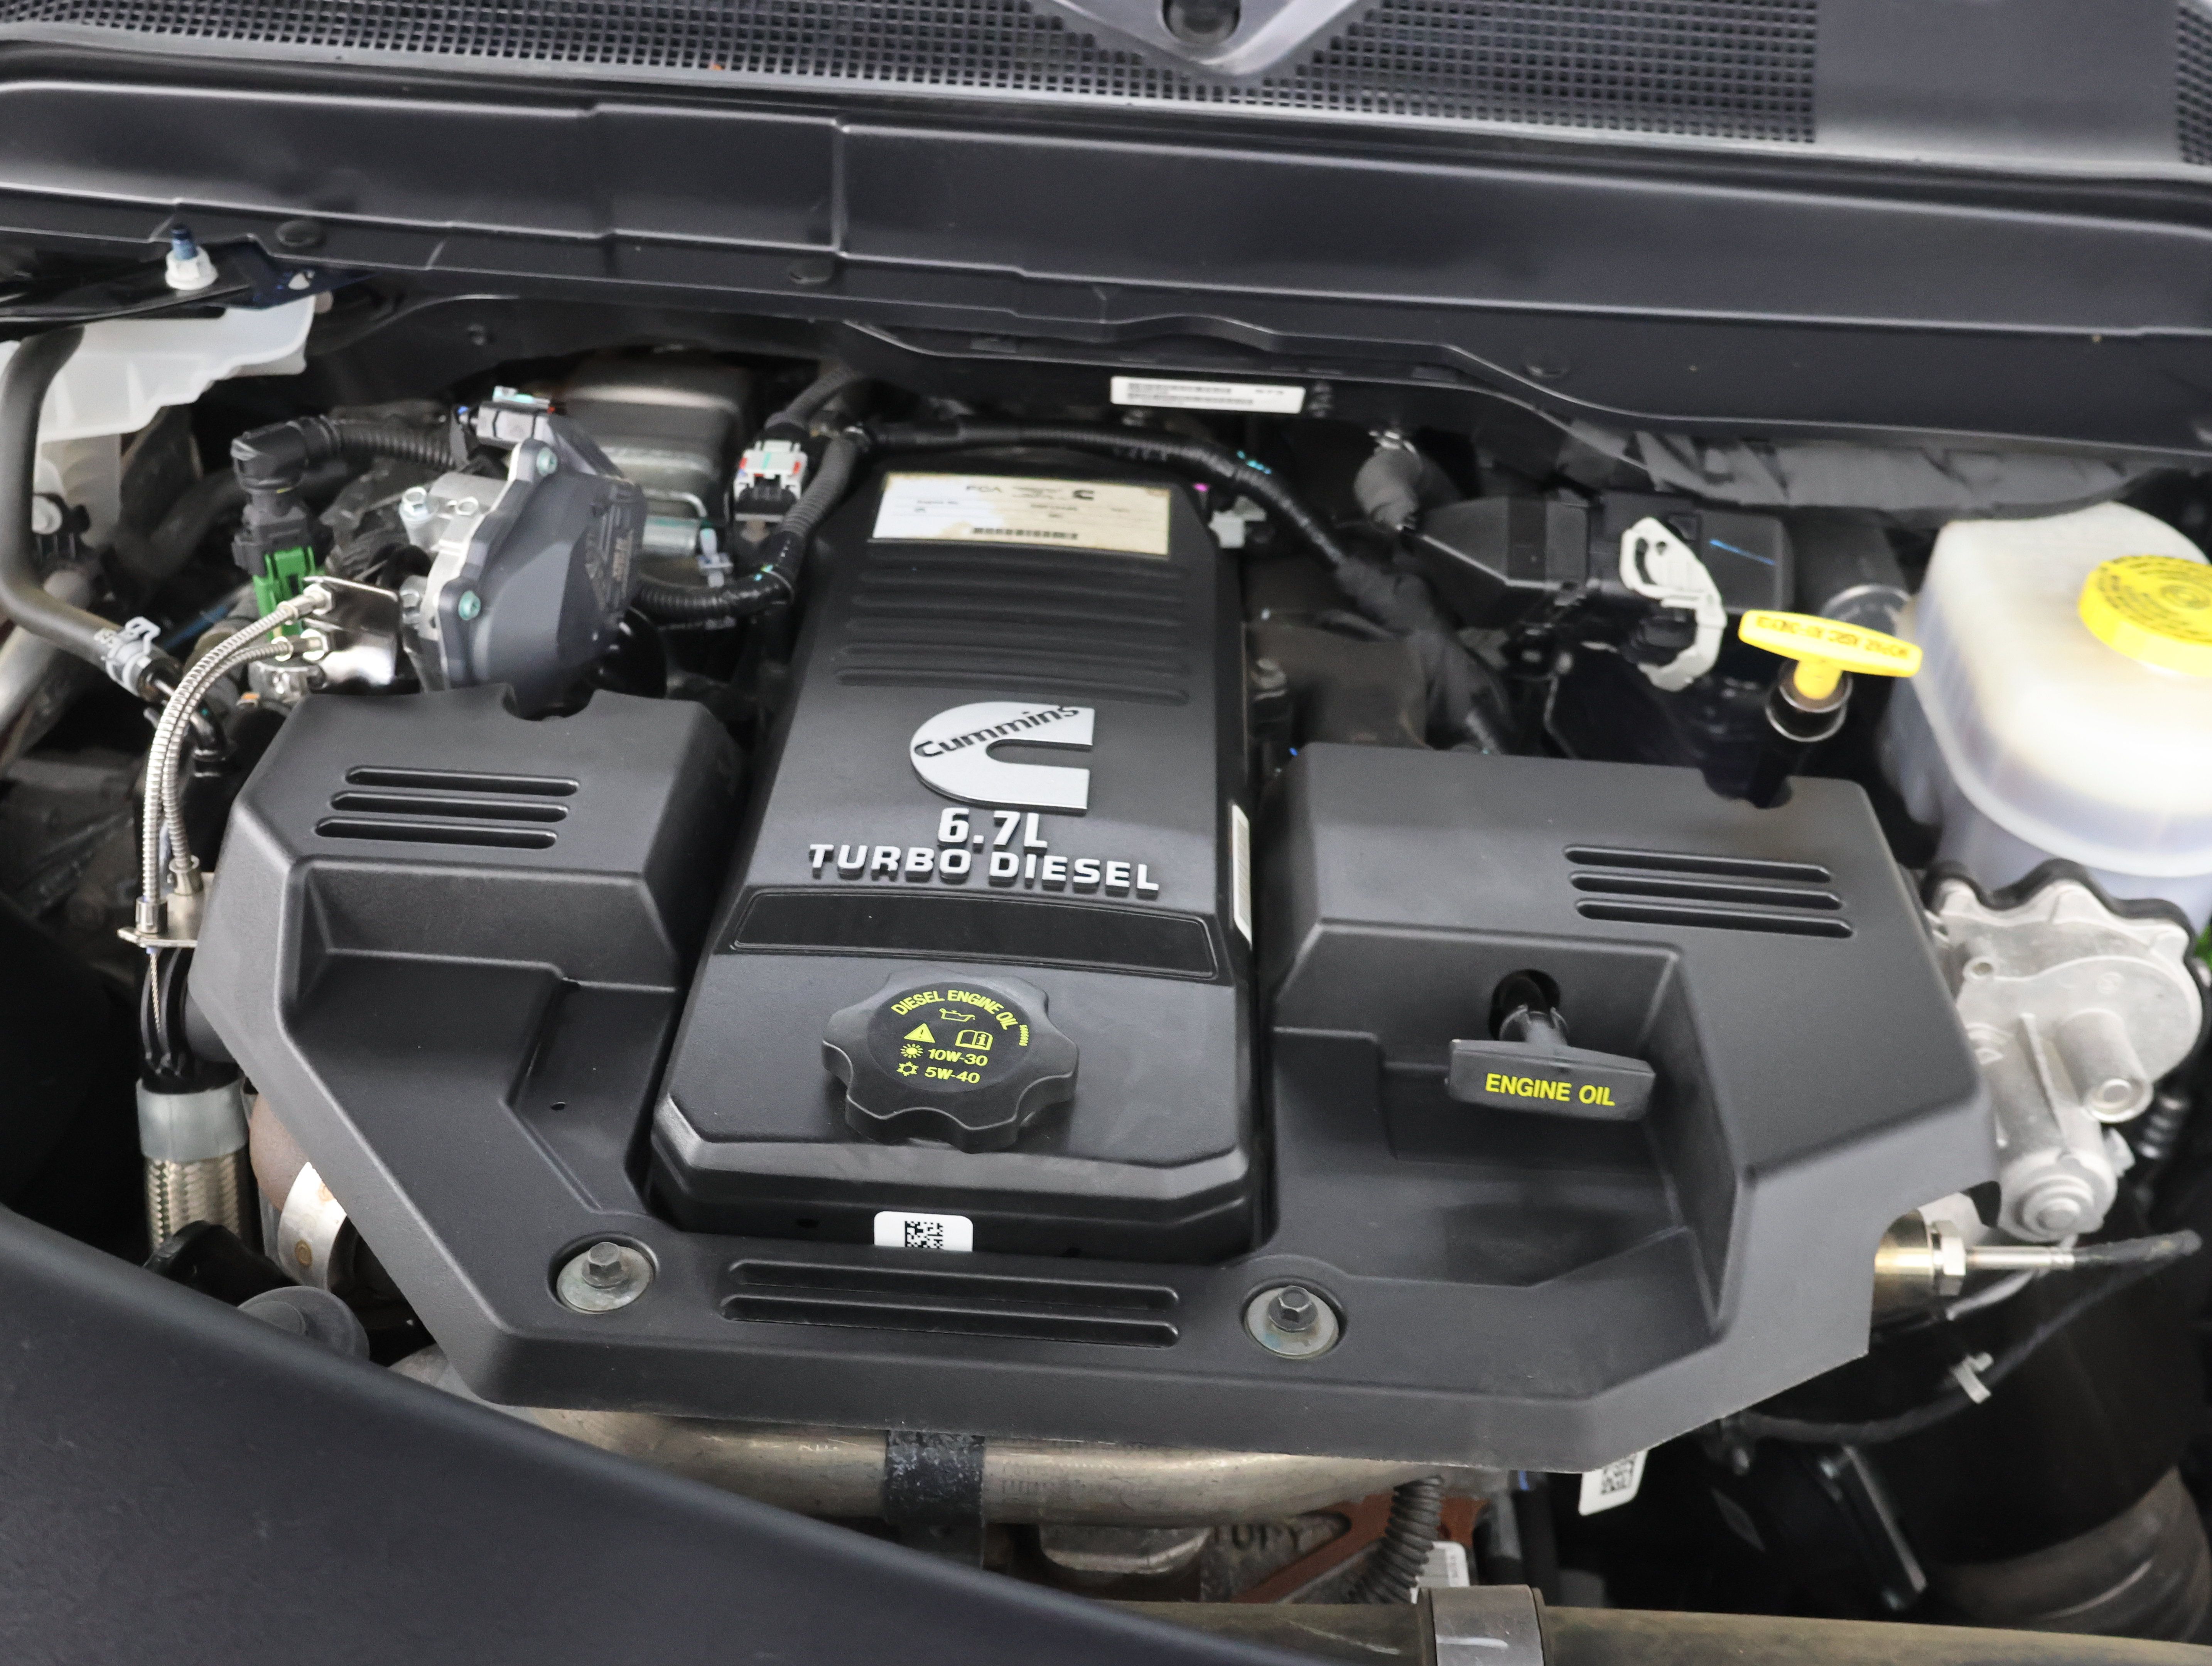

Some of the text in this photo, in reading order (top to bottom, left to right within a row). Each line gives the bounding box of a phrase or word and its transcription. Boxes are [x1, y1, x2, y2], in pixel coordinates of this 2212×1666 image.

[914, 705, 1080, 757] Cummins
[937, 808, 1048, 849] 6.7L
[809, 844, 1159, 893] TURBO DIESEL
[891, 990, 1018, 1030] DIESEL ENGINE OIL
[924, 1066, 980, 1084] 5W-40
[928, 1048, 988, 1067] 10W-30
[1485, 1072, 1616, 1106] ENGINE OIL
